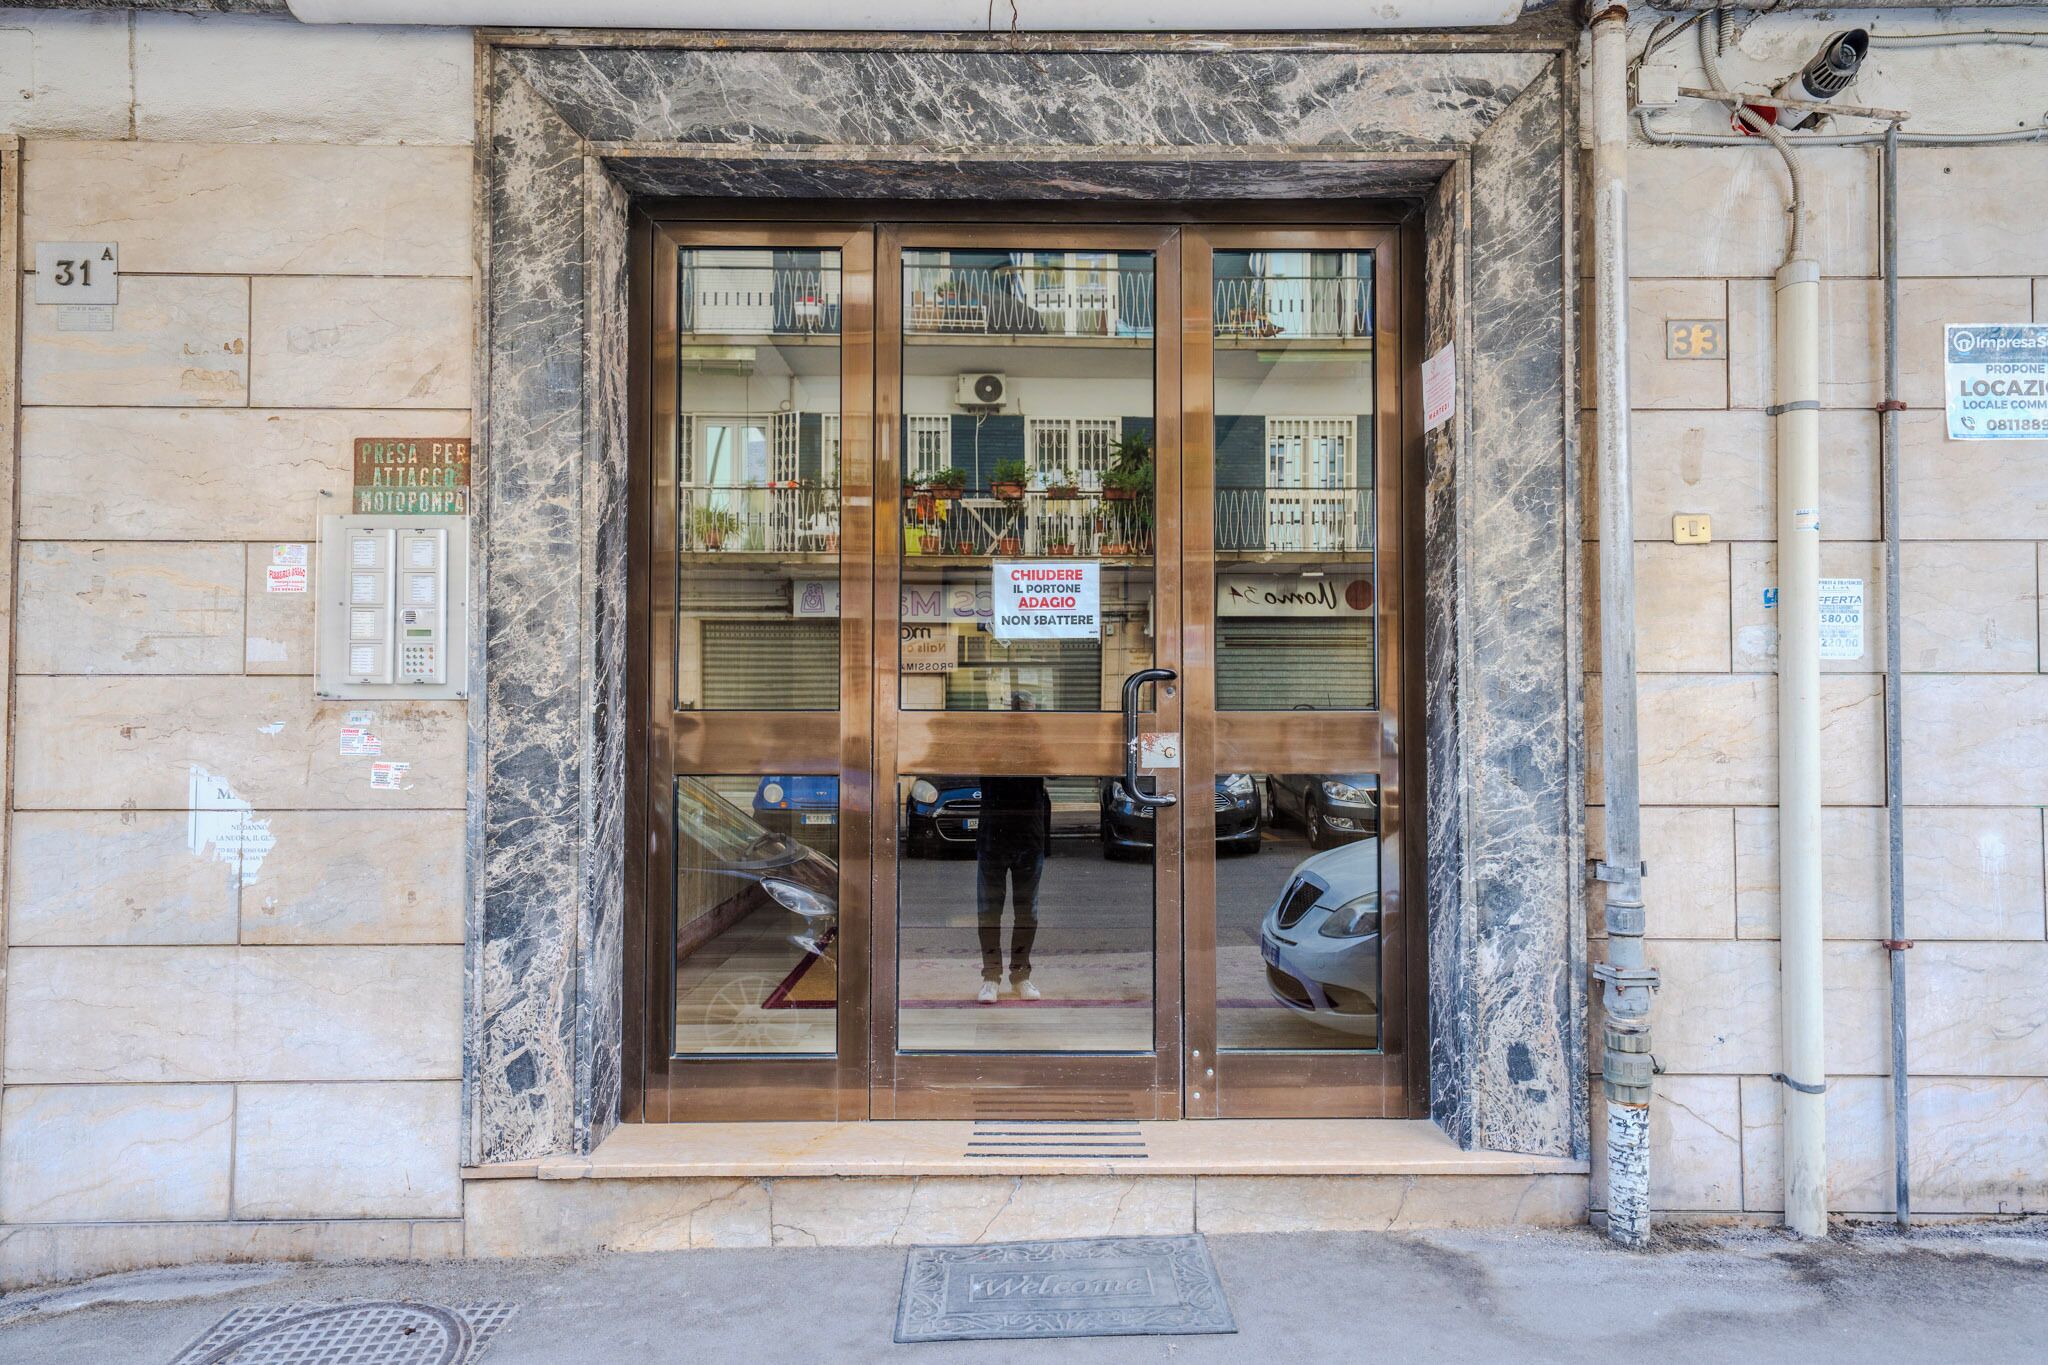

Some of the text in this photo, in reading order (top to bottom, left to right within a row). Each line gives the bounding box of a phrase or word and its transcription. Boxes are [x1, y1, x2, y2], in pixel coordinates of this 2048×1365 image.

[101, 247, 114, 261] A
[55, 259, 91, 287] 31
[1674, 323, 1718, 355] 33
[1976, 335, 2048, 351] ImpresaS
[1985, 364, 2046, 374] PROPONE
[1960, 379, 2048, 397] LOCAZI
[1962, 400, 2009, 410] LOCALE
[362, 443, 467, 464] PRESA PER
[373, 466, 455, 487] ATTACCO
[361, 490, 464, 513] MOTOPOMPA
[1011, 569, 1083, 581] CHIUDERE
[1013, 584, 1081, 593] IL PORTONE
[1018, 597, 1076, 608] ADAGIO
[1001, 615, 1094, 626] NON SBATTERE
[982, 1273, 1144, 1298] Welcome
